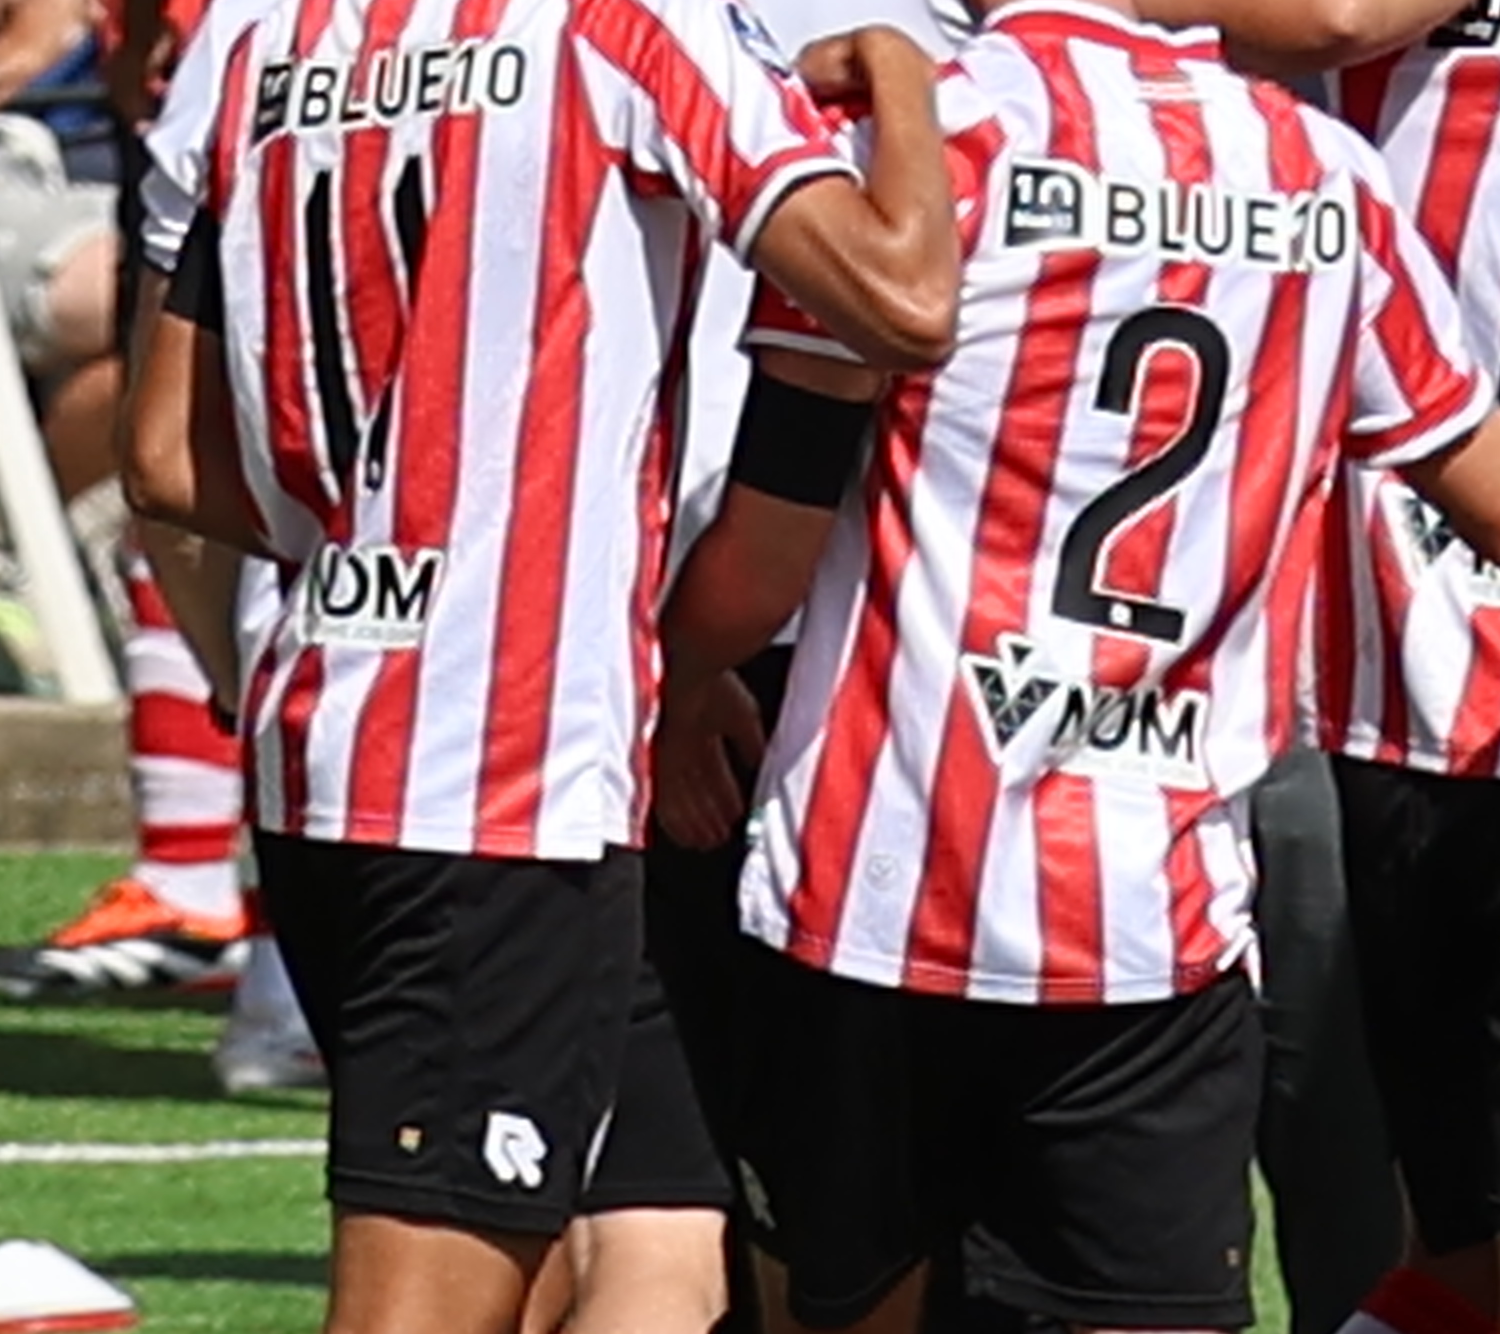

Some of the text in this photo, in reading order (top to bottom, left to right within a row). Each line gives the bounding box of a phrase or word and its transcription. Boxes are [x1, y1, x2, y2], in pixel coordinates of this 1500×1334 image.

[298, 45, 527, 128] BLUE10
[1107, 182, 1348, 265] BLUE10
[1051, 304, 1231, 645] 2
